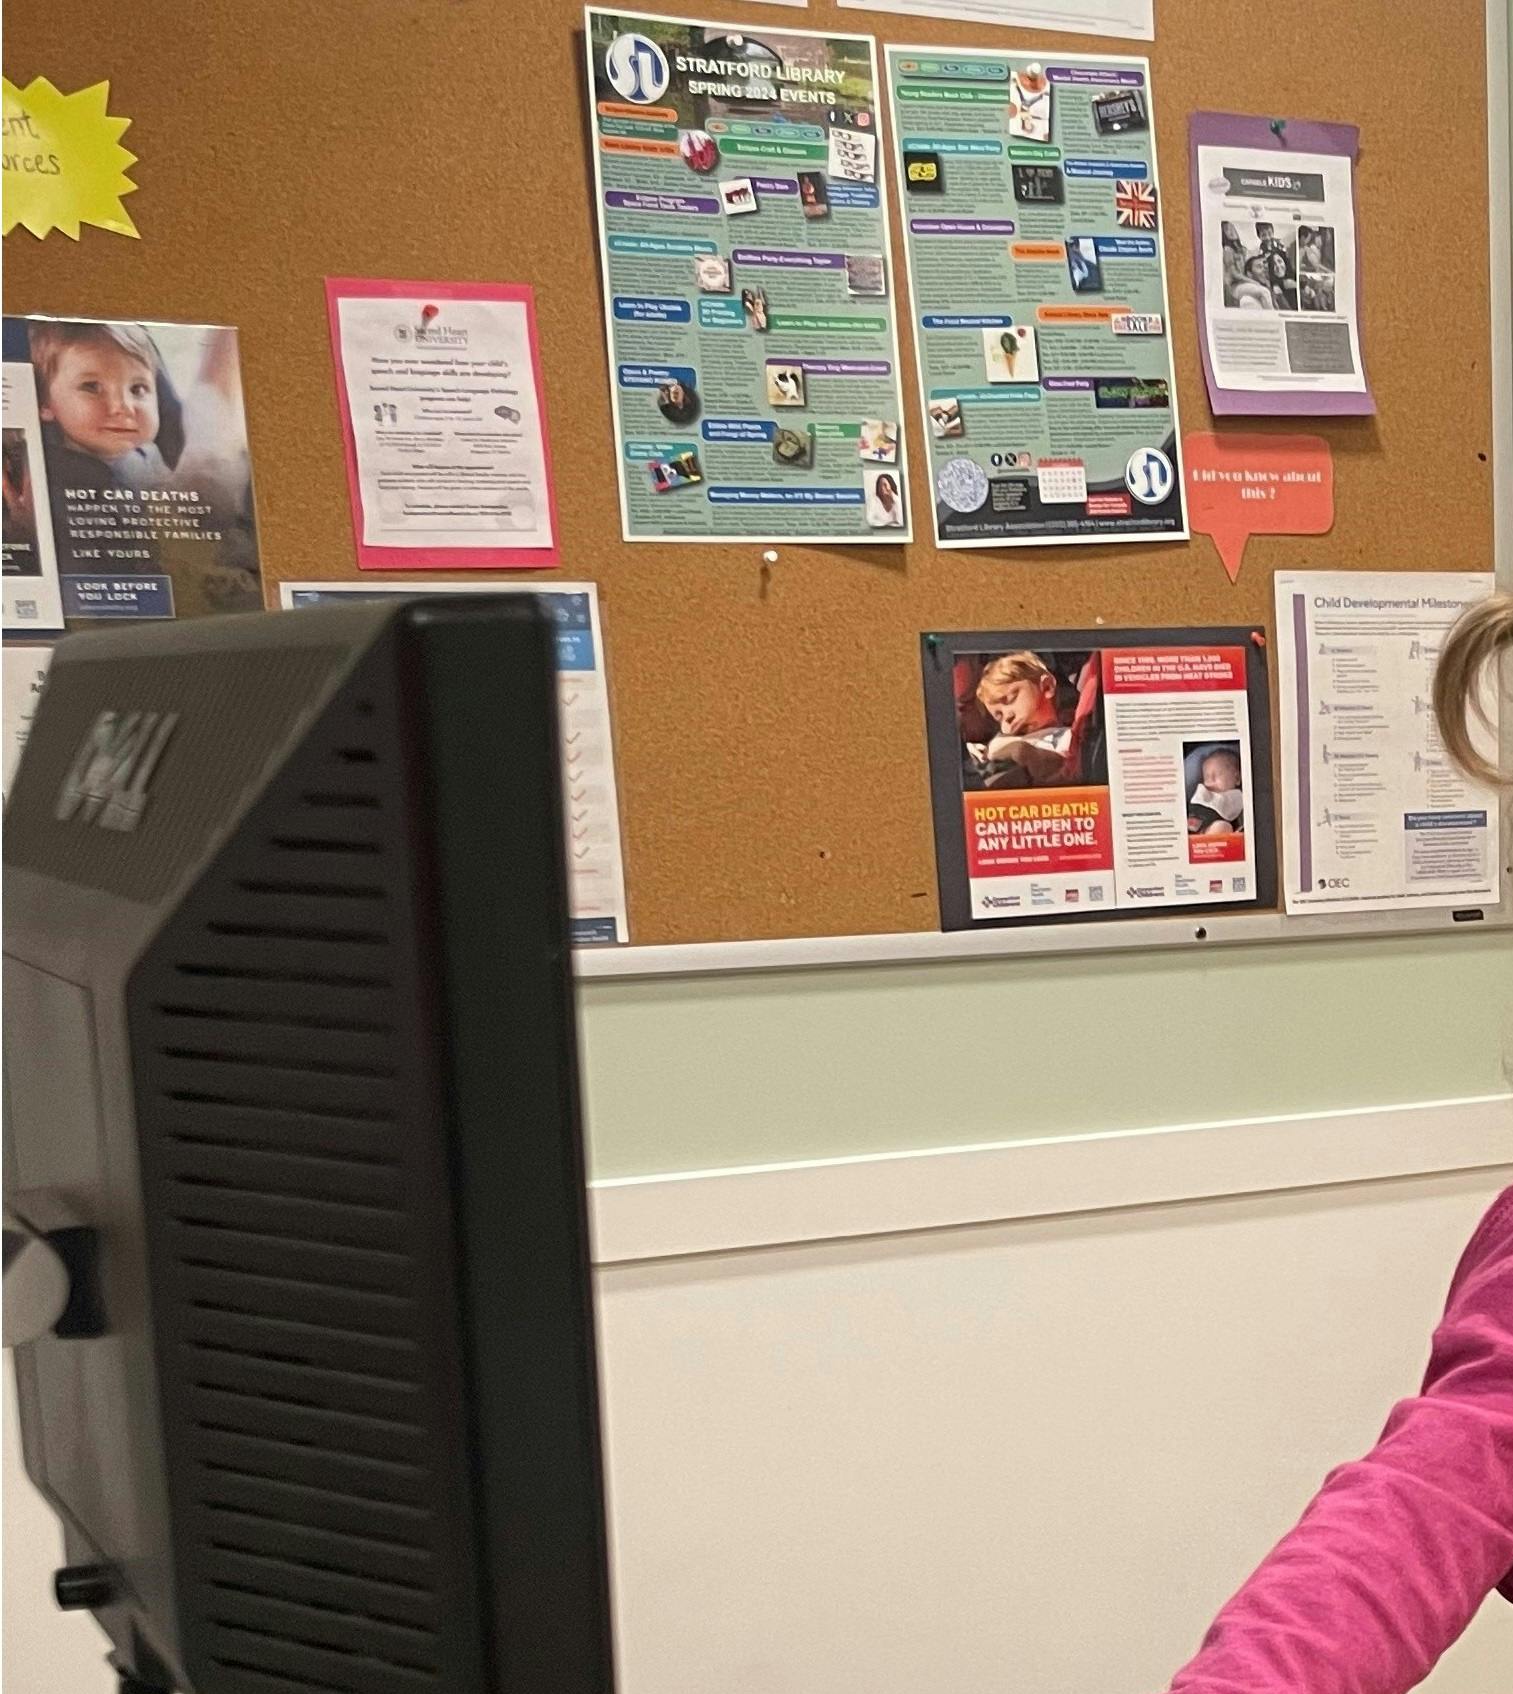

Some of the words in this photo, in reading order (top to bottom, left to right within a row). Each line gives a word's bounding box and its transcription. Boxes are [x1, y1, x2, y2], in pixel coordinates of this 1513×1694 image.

[675, 56, 772, 79] STRATFORD
[776, 66, 845, 85] LIBRARY
[688, 79, 743, 98] SPRING
[745, 85, 777, 100] 2024
[780, 89, 836, 104] EVENTS
[1193, 469, 1216, 482] Did
[1218, 471, 1243, 482] you
[1245, 470, 1279, 482] know
[1282, 471, 1322, 483] about
[64, 488, 97, 501] HOT
[103, 489, 134, 501] CAR
[140, 490, 200, 502] DEATHS
[1241, 487, 1266, 499] this
[66, 503, 119, 514] HAPPEN
[124, 504, 141, 514] TO
[148, 504, 171, 514] THE
[176, 505, 212, 514] MOST
[68, 517, 118, 526] LOVING
[122, 517, 200, 528] PROTECTIVE
[69, 529, 158, 540] RESPONSIBLE
[164, 531, 222, 540] FAMILIES
[72, 549, 102, 558] LIKE
[76, 582, 108, 591] LOOK
[113, 582, 158, 591] BEFORE
[79, 592, 103, 601] YOU
[107, 592, 137, 601] LOCK
[1314, 597, 1341, 609] Child
[1343, 597, 1419, 610] Developmental
[1422, 597, 1466, 609] Mileston
[974, 805, 1007, 820] HOT
[1009, 804, 1039, 819] CAR
[1041, 802, 1099, 818] DEATHS
[975, 820, 1009, 836] CAN
[1012, 818, 1071, 834] HAPPEN
[1075, 817, 1096, 830] TO
[976, 836, 1011, 851] ANY
[1012, 833, 1060, 849] LITTLE
[1063, 831, 1098, 846] ONE.
